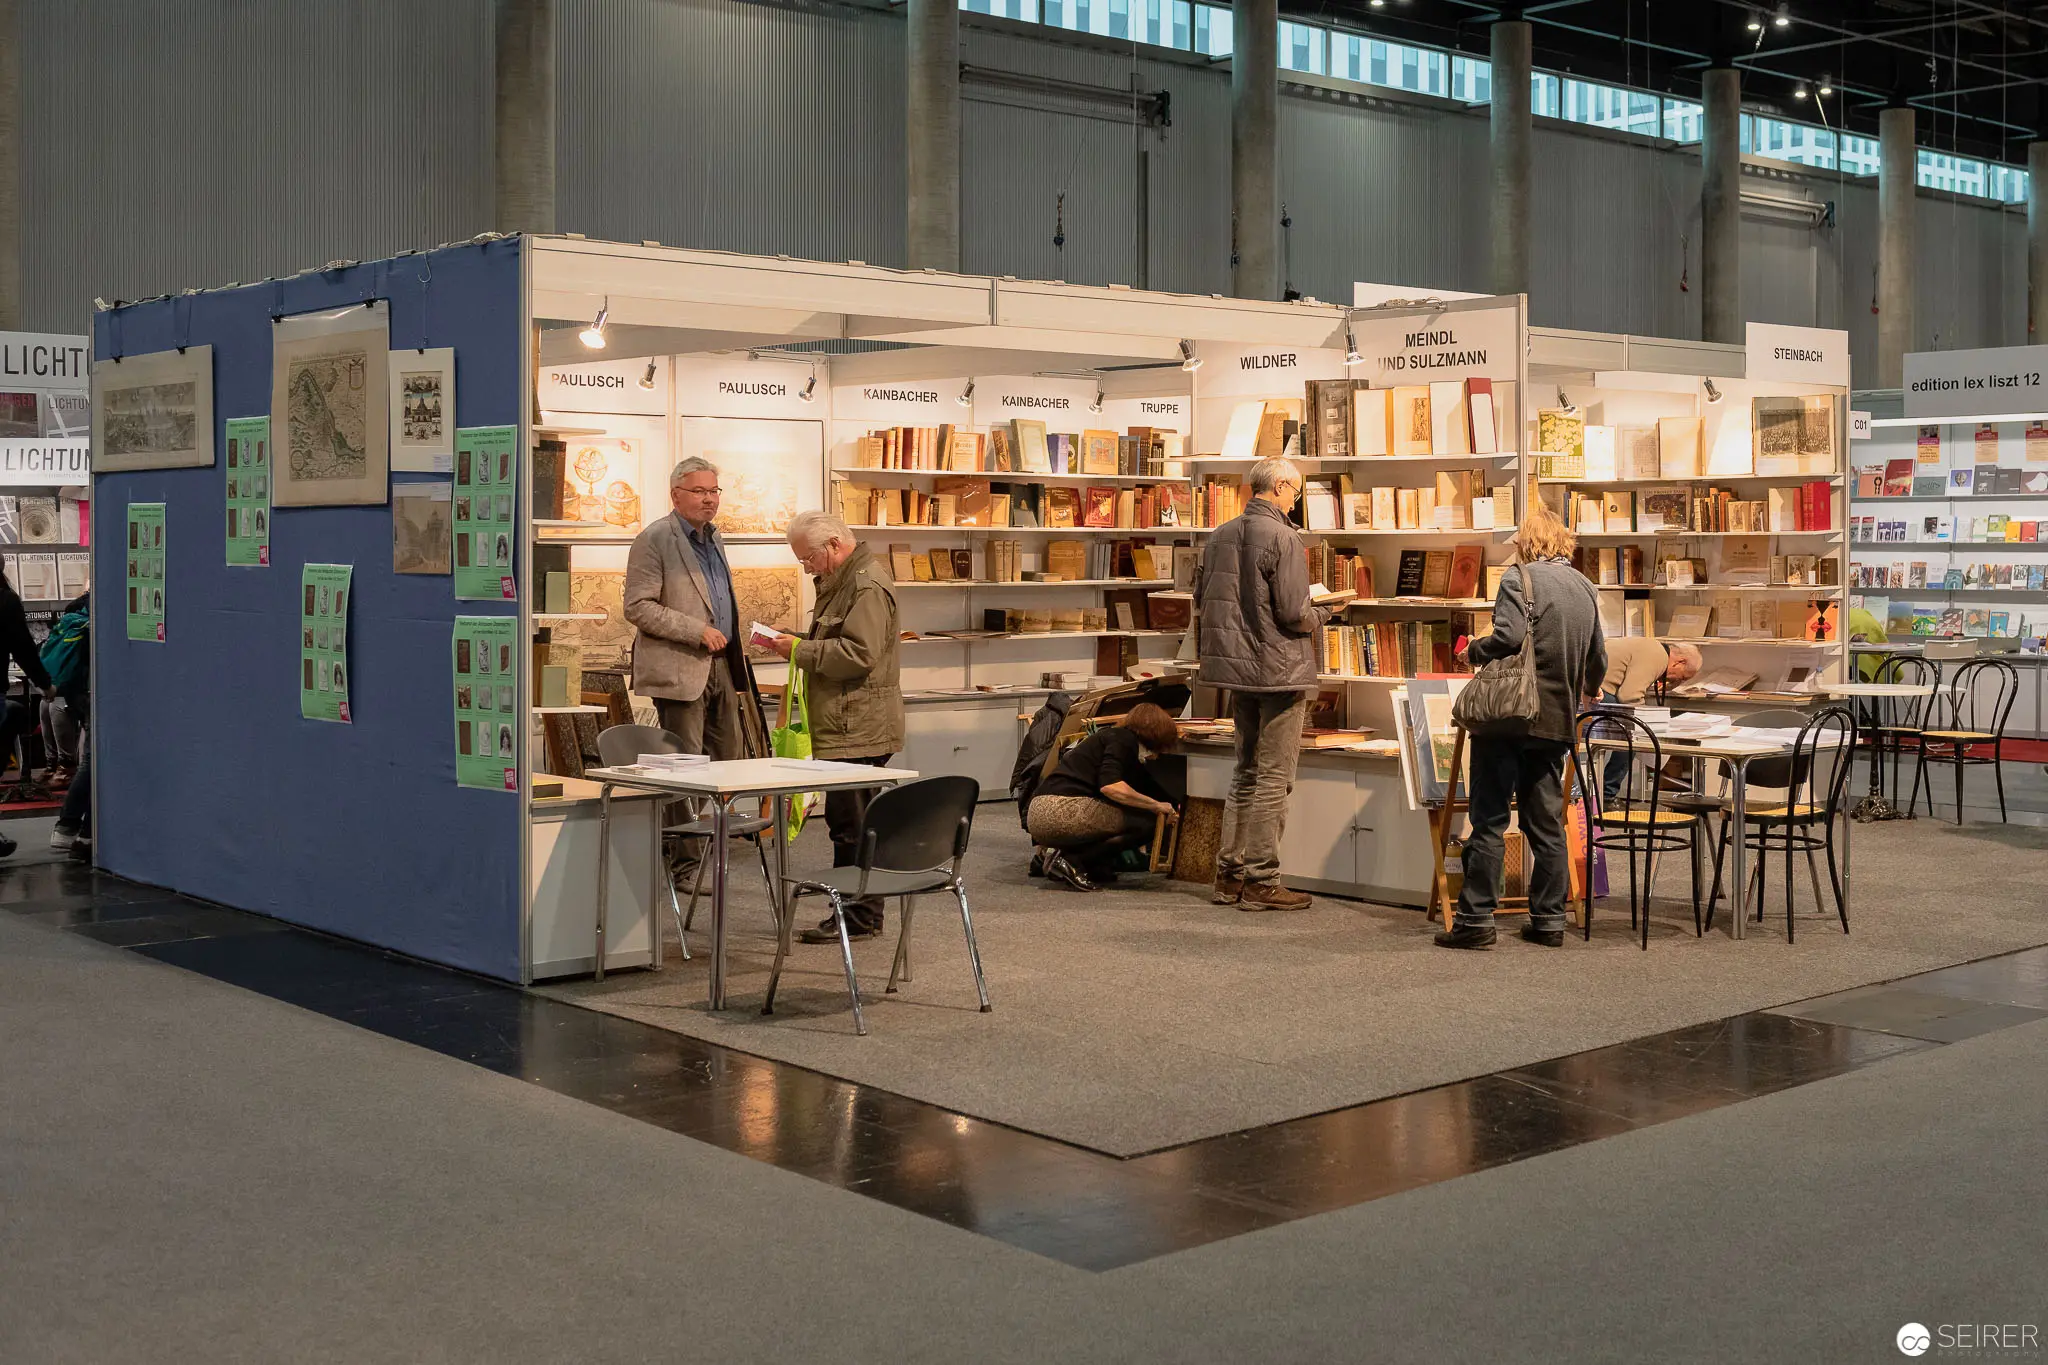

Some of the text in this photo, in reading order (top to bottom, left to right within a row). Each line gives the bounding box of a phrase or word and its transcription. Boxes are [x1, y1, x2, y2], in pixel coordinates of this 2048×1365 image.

[1405, 330, 1458, 348] MEINDL
[4, 344, 90, 378] LICHT
[1240, 354, 1297, 370] WILDNER
[1378, 350, 1487, 371] UND SULZMANN
[1774, 347, 1823, 362] STEINBACH
[552, 373, 624, 388] PAULUSCH
[1911, 372, 2041, 392] edition lex liszt 12
[719, 382, 786, 396] PAULUSCH
[864, 388, 938, 403] KAINBACHER
[1002, 395, 1070, 409] KAINBACHER
[1141, 402, 1179, 414] TRUPPE
[1854, 419, 1868, 431] C01
